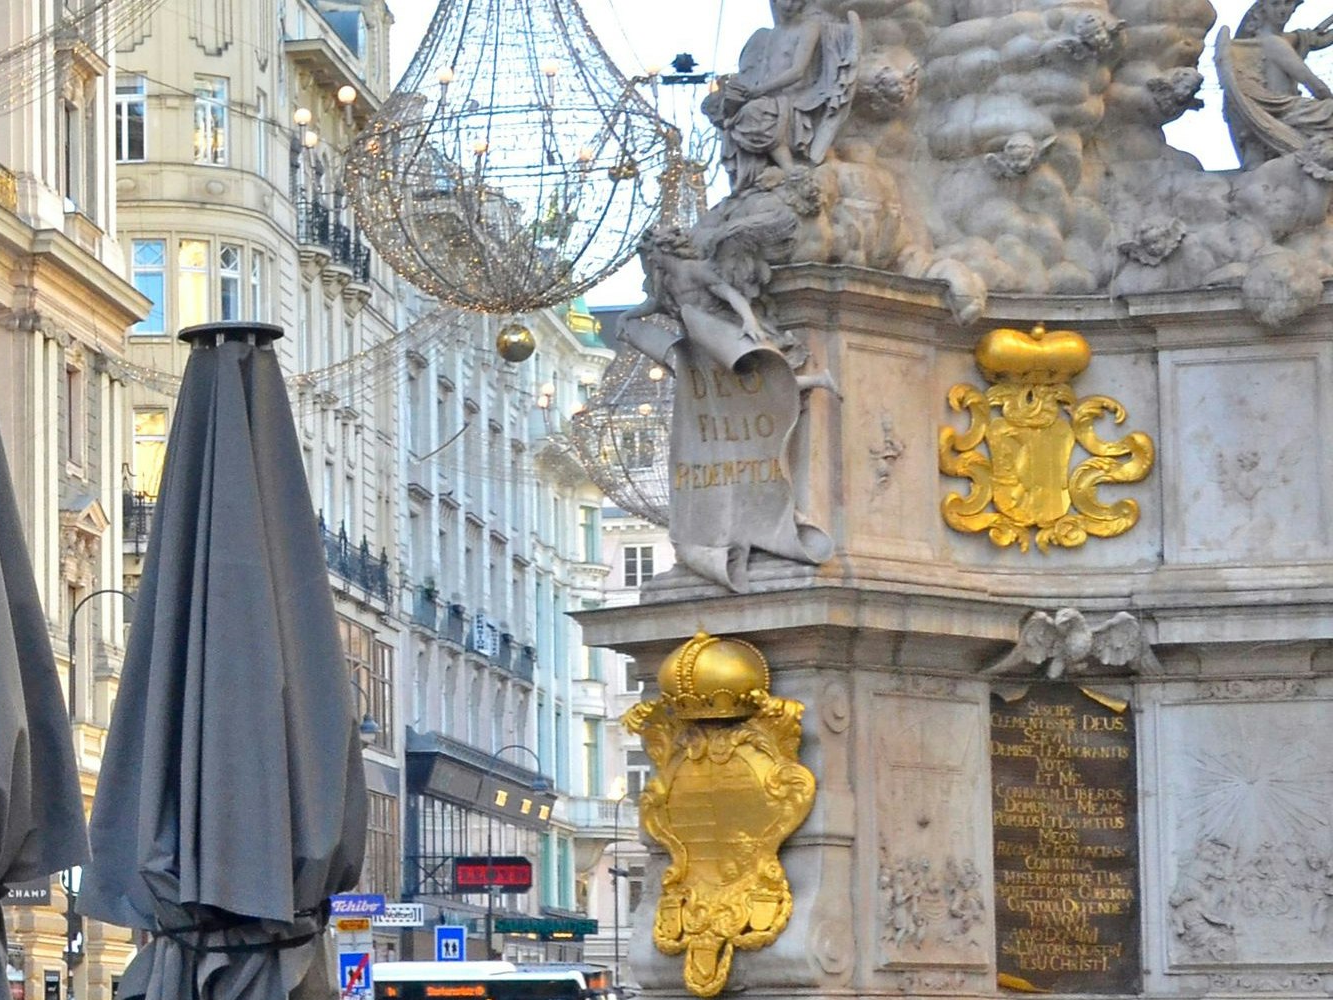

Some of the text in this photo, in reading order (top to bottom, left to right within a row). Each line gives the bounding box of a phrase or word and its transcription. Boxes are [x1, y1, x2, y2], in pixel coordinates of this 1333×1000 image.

[698, 413, 774, 442] FILIO
[8, 889, 47, 898] CHAMP
[331, 900, 381, 914] Tchibo
